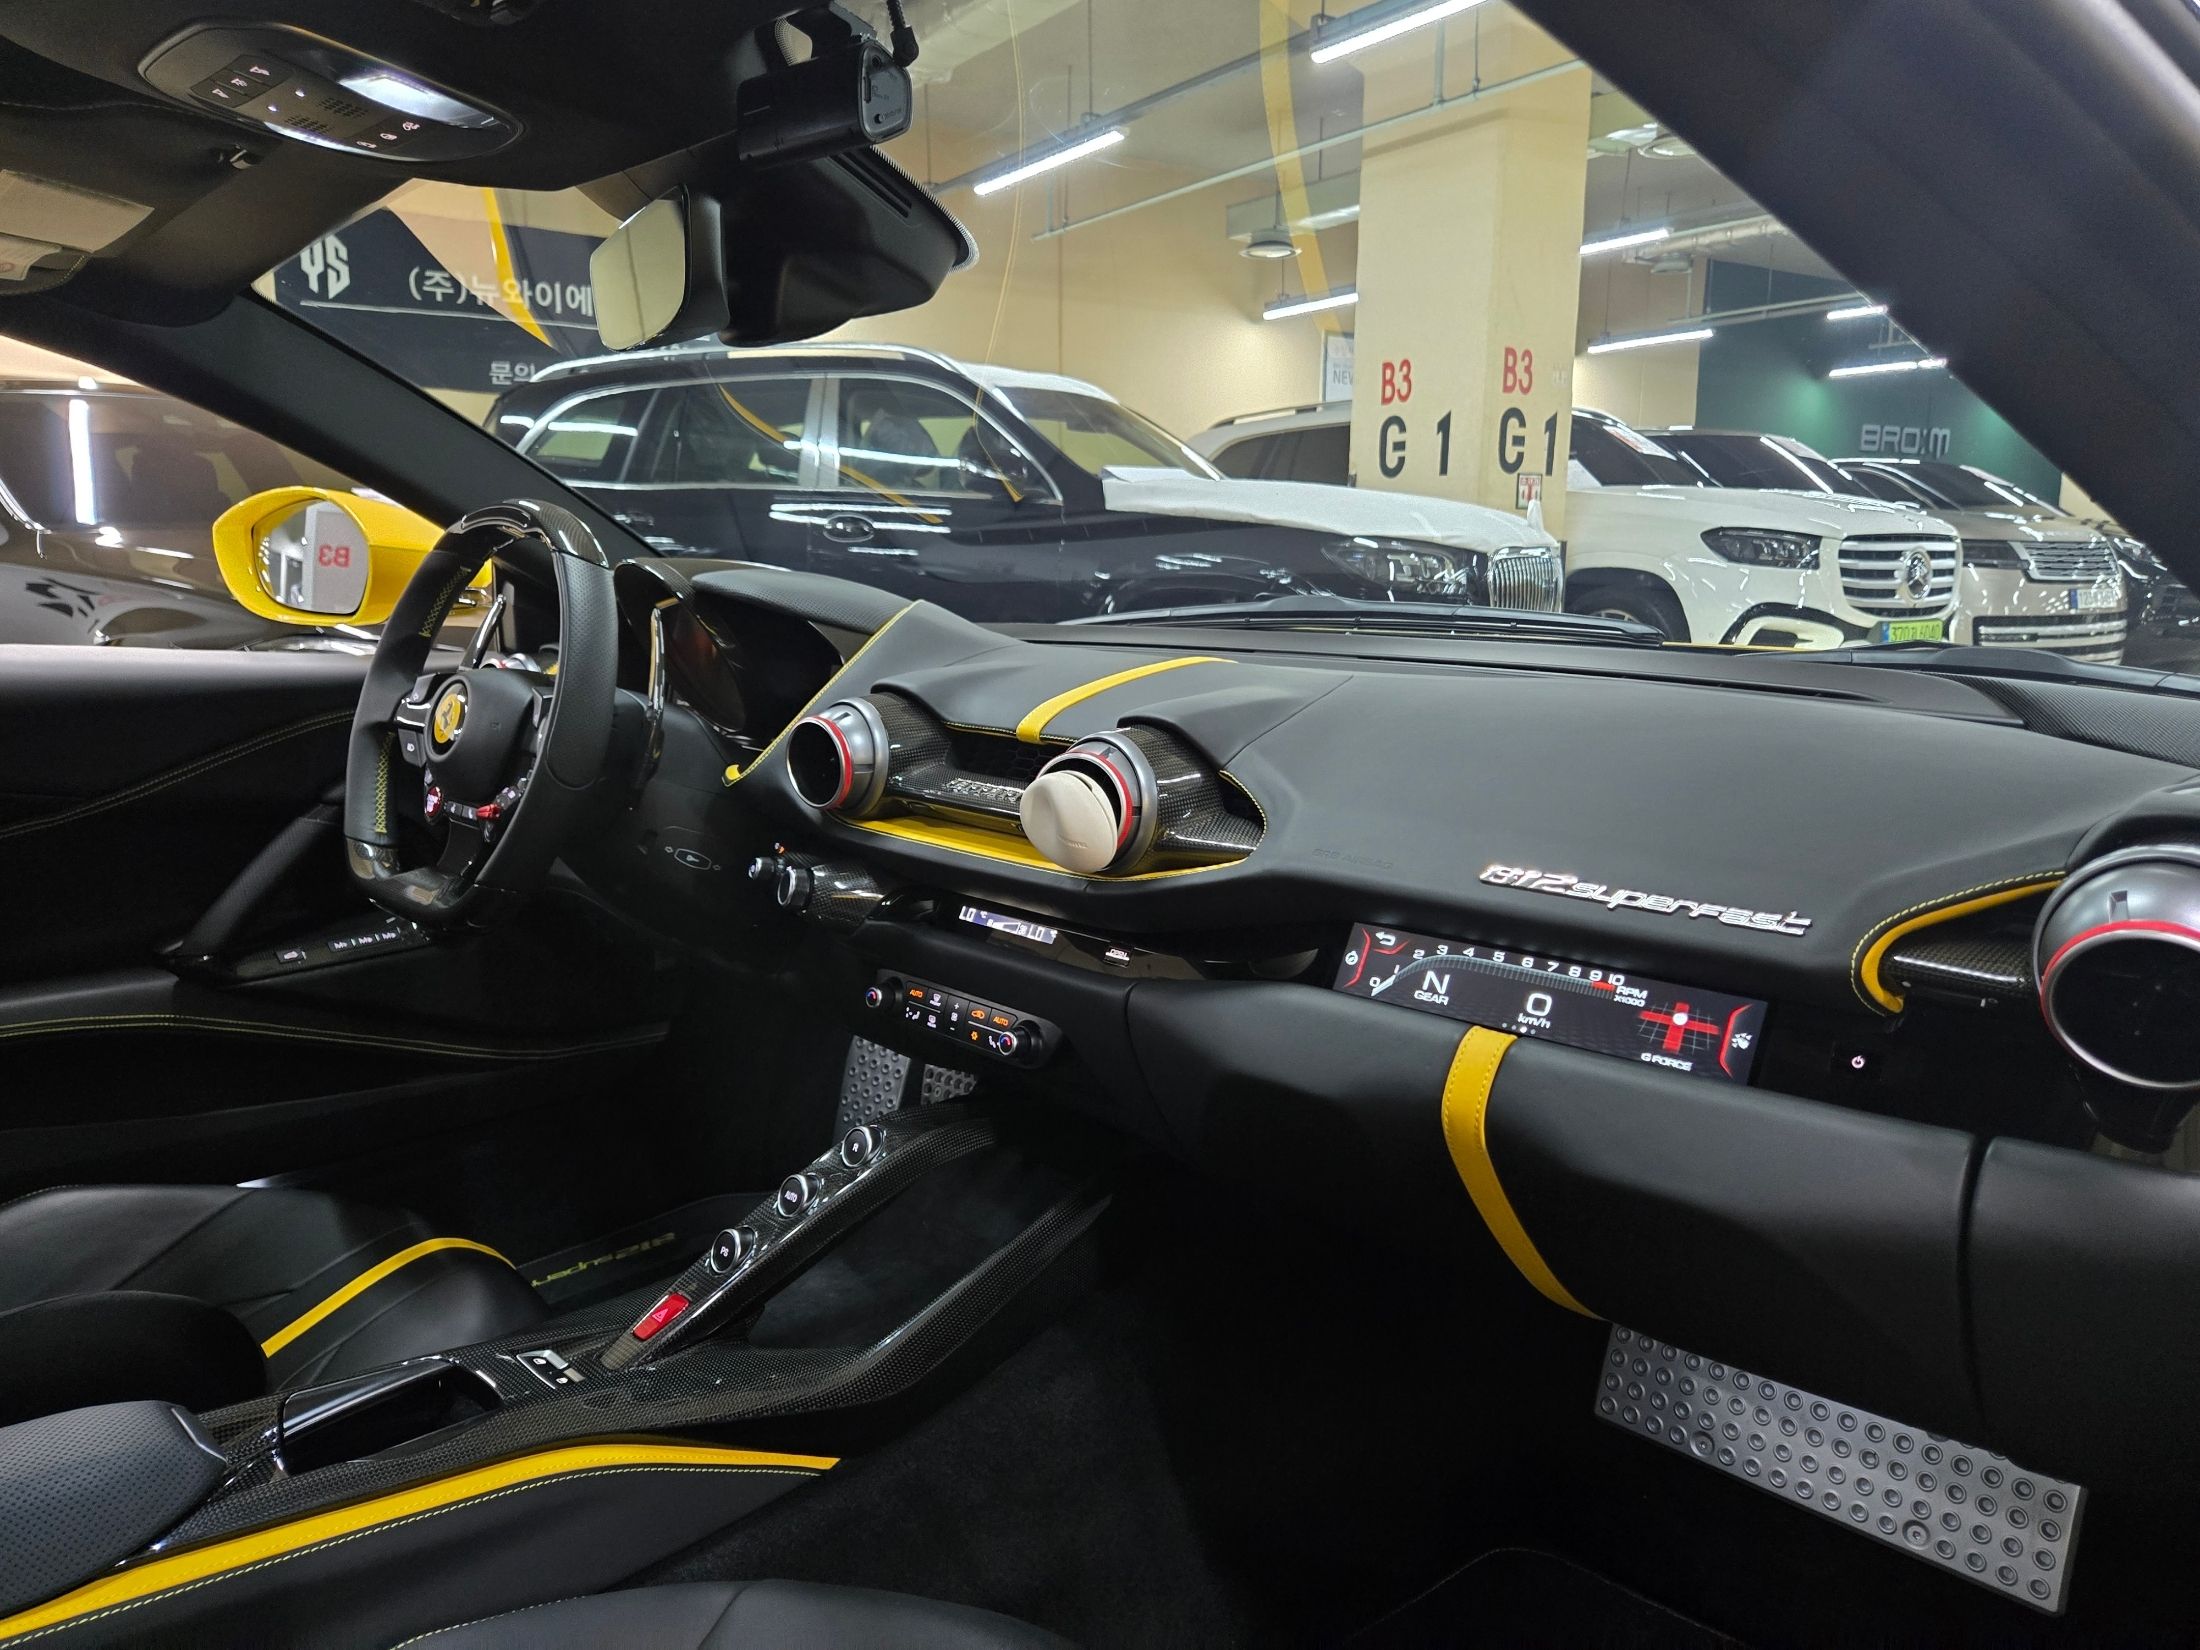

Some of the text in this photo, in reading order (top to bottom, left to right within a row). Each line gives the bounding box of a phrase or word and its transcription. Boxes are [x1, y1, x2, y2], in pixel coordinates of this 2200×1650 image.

[1502, 347, 1533, 395] B3
[1380, 358, 1412, 406] B3
[1379, 410, 1452, 479] G 1
[1499, 407, 1558, 477] G 1
[1412, 949, 1425, 960] 2
[1436, 944, 1449, 956] 3
[1463, 947, 1475, 958] 4
[1492, 951, 1506, 963] 5
[1521, 957, 1534, 968] 6
[1547, 961, 1560, 972] 7
[1568, 966, 1582, 978] 8
[1589, 970, 1603, 982] 9
[1608, 973, 1625, 986] 10
[1422, 970, 1450, 995] N
[909, 989, 923, 998] AUTO
[1414, 990, 1449, 1006] GEAR
[1616, 986, 1648, 1000] RPM
[1526, 992, 1552, 1016] 0
[992, 1015, 1009, 1026] AUTO
[1517, 1013, 1551, 1029] km/h
[1641, 1052, 1693, 1072] G FORCE
[852, 1142, 859, 1152] R
[784, 1190, 798, 1203] AUTO
[719, 1246, 729, 1257] PS
